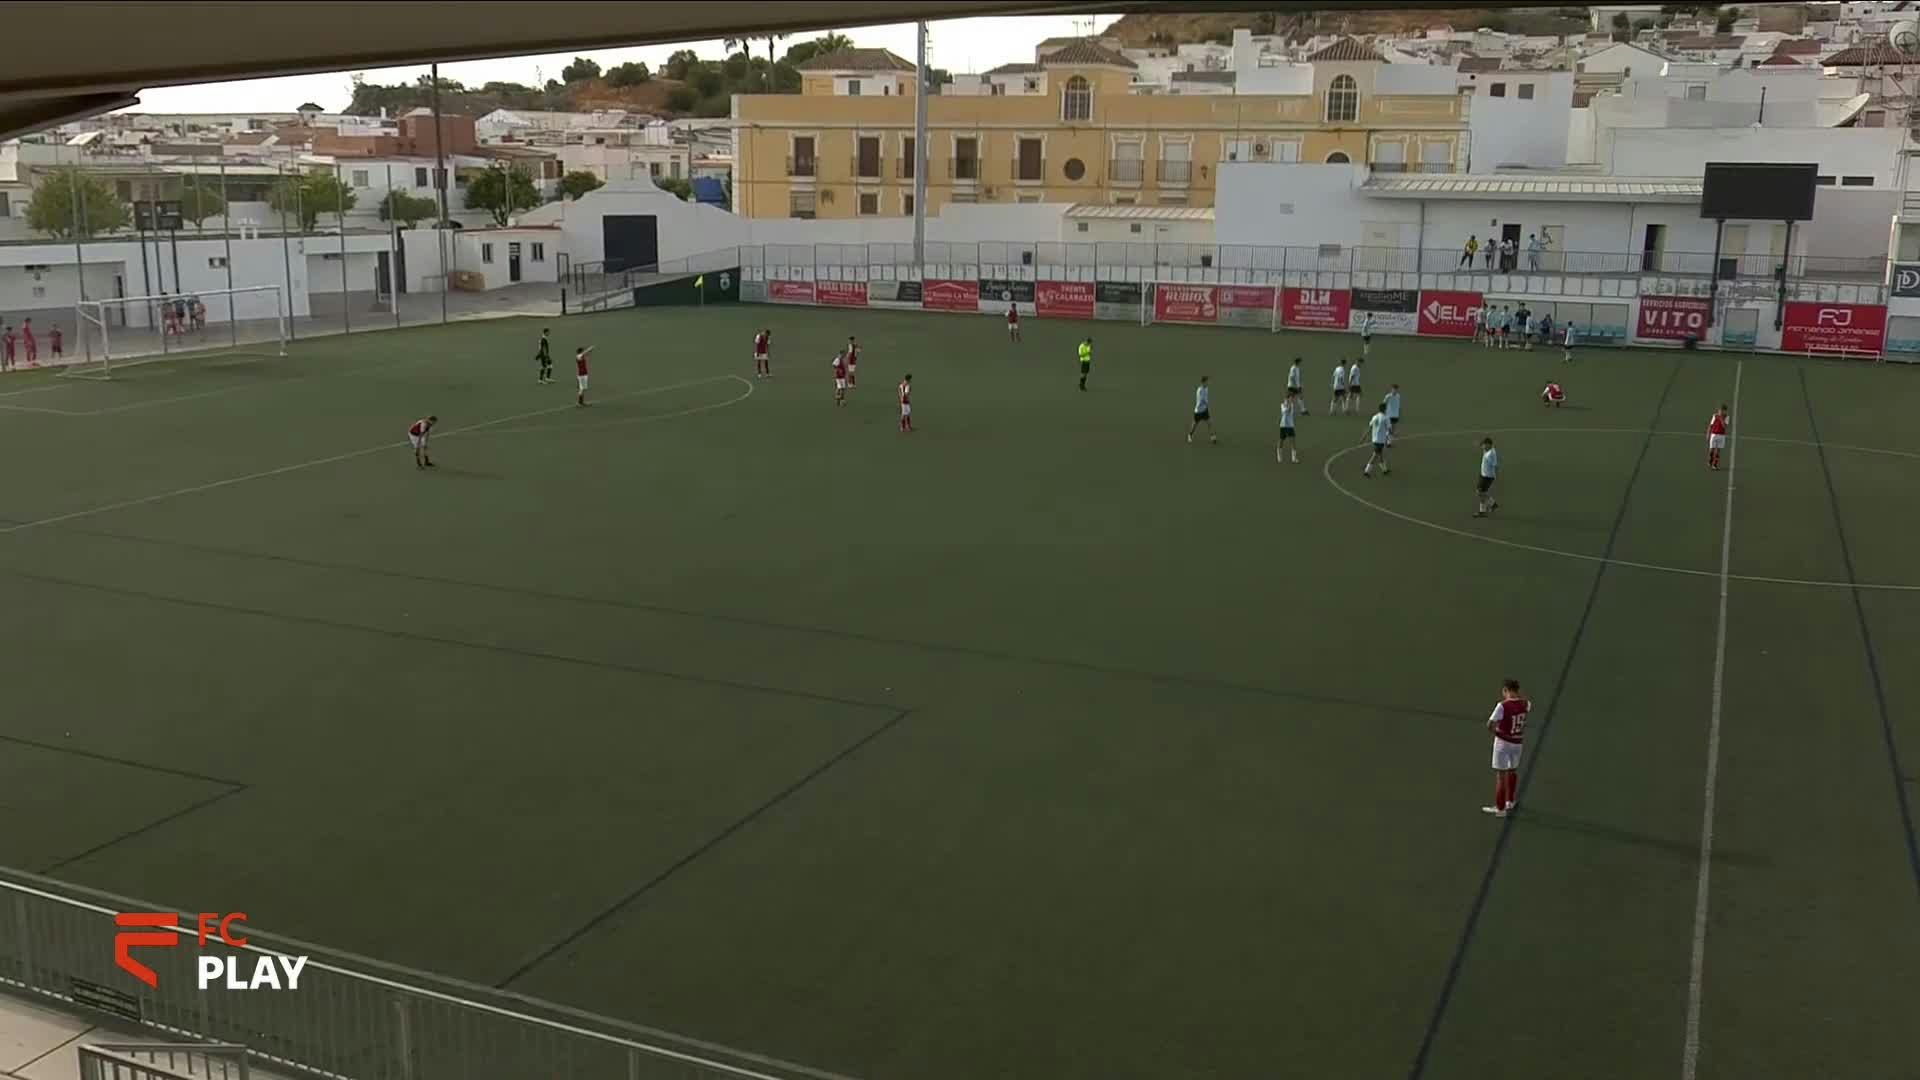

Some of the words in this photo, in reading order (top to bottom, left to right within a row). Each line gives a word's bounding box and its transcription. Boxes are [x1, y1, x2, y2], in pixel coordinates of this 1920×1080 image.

[1300, 289, 1331, 305] DLM
[1645, 310, 1703, 329] VITO
[1817, 308, 1853, 326] FJ
